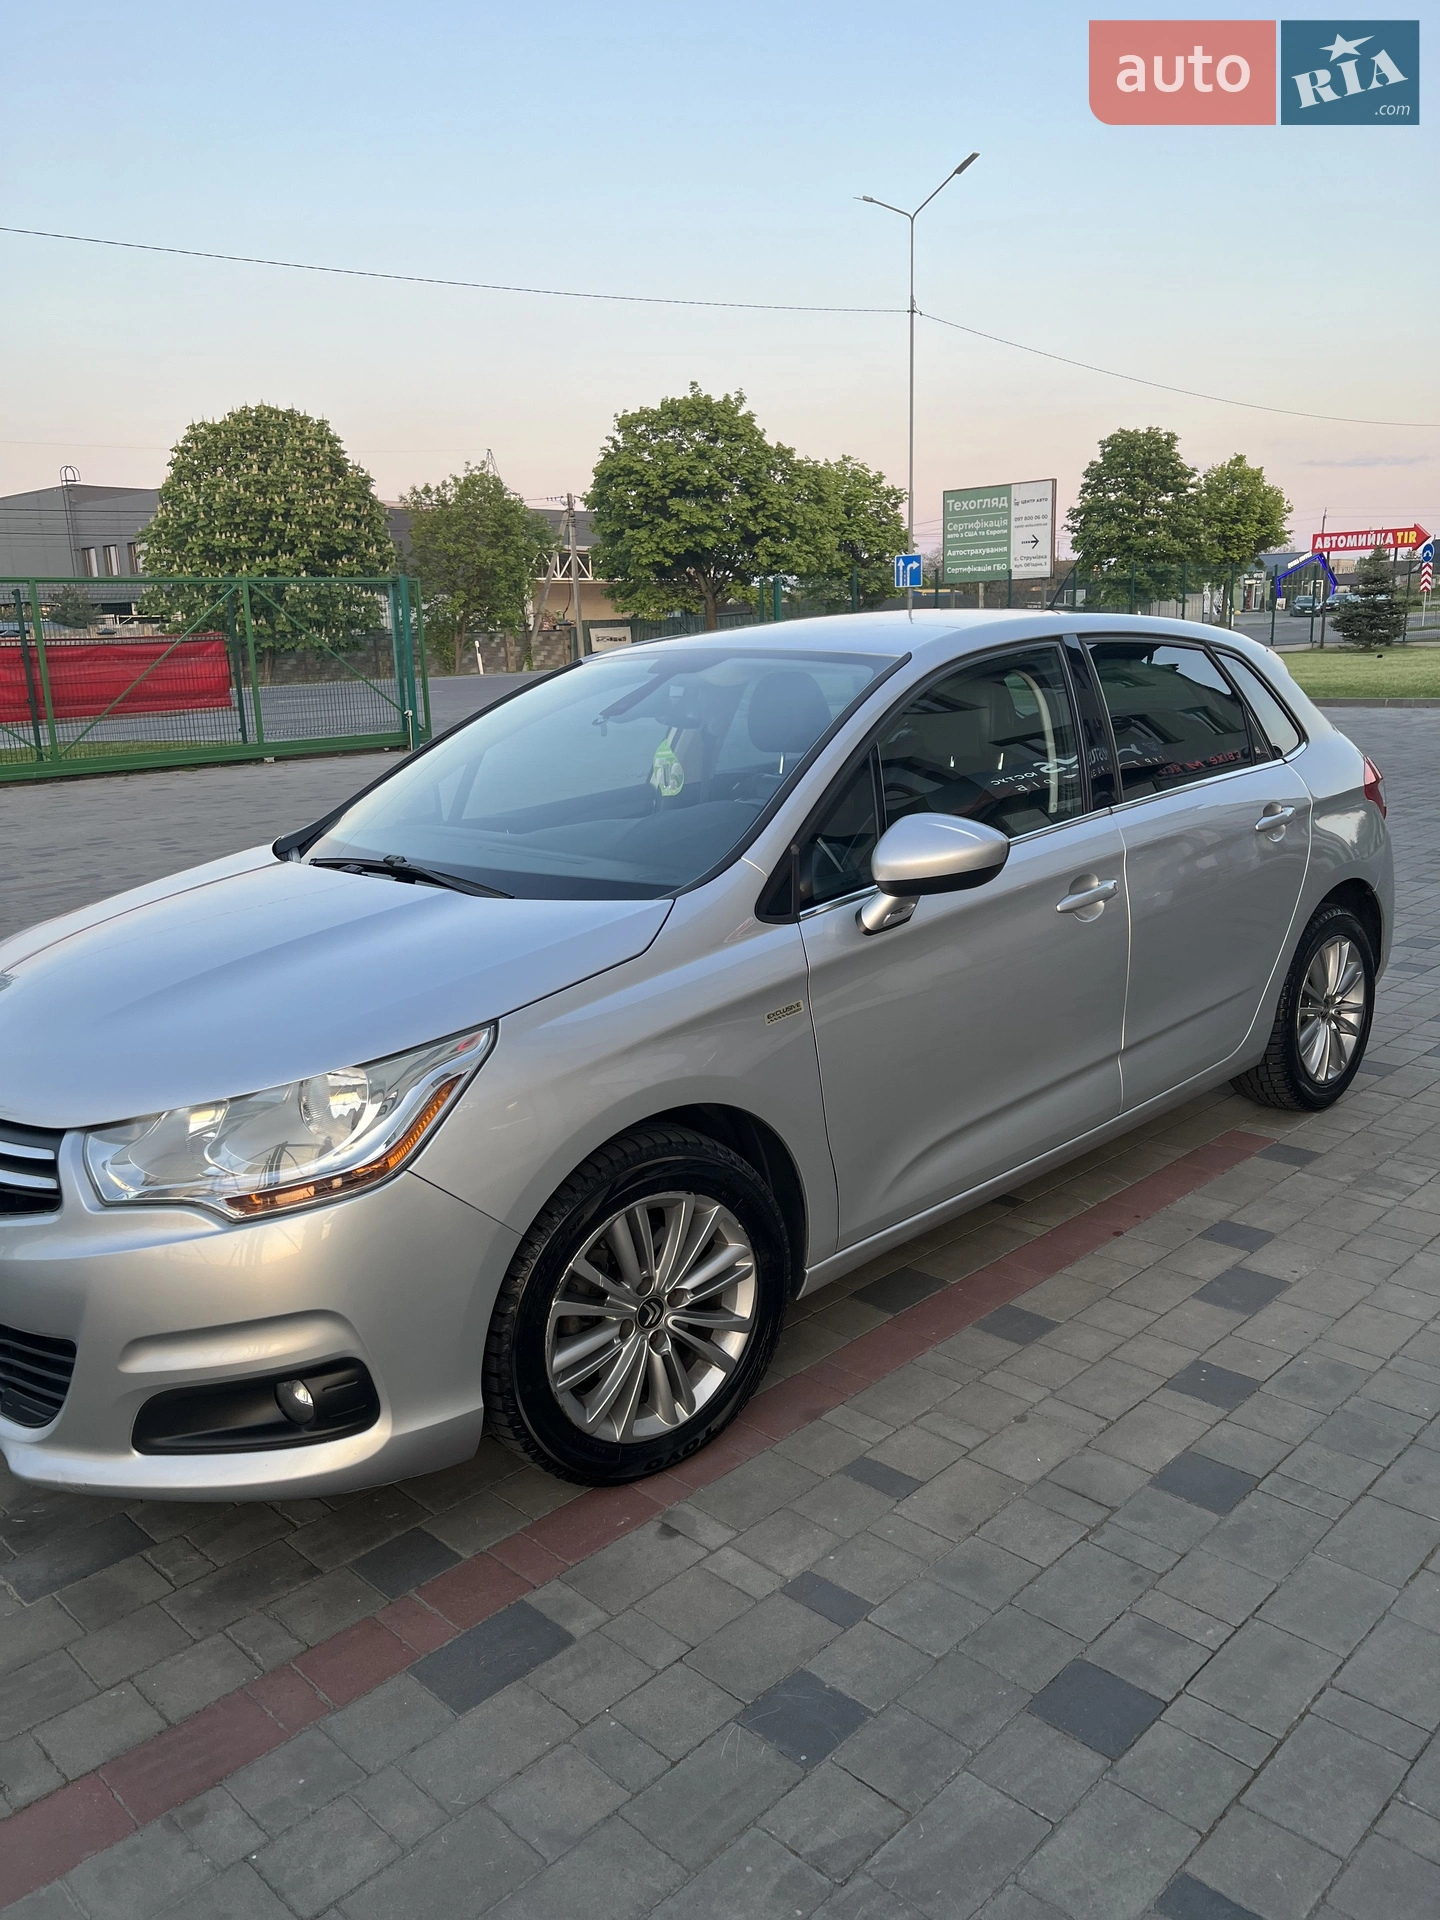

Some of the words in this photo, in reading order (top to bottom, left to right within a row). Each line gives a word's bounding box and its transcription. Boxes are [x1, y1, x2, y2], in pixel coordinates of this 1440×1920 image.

[947, 497, 1008, 511] Техогляд
[947, 517, 1008, 532] Сертифікація
[1315, 532, 1393, 549] АВТОМИЙКА
[1396, 530, 1417, 544] TIR
[947, 547, 1007, 556] Автострахування
[1020, 554, 1048, 562] Струмівка
[946, 564, 992, 575] Сертифікація
[993, 563, 1007, 571] ГБО
[766, 1001, 801, 1020] EXCLUSIVE
